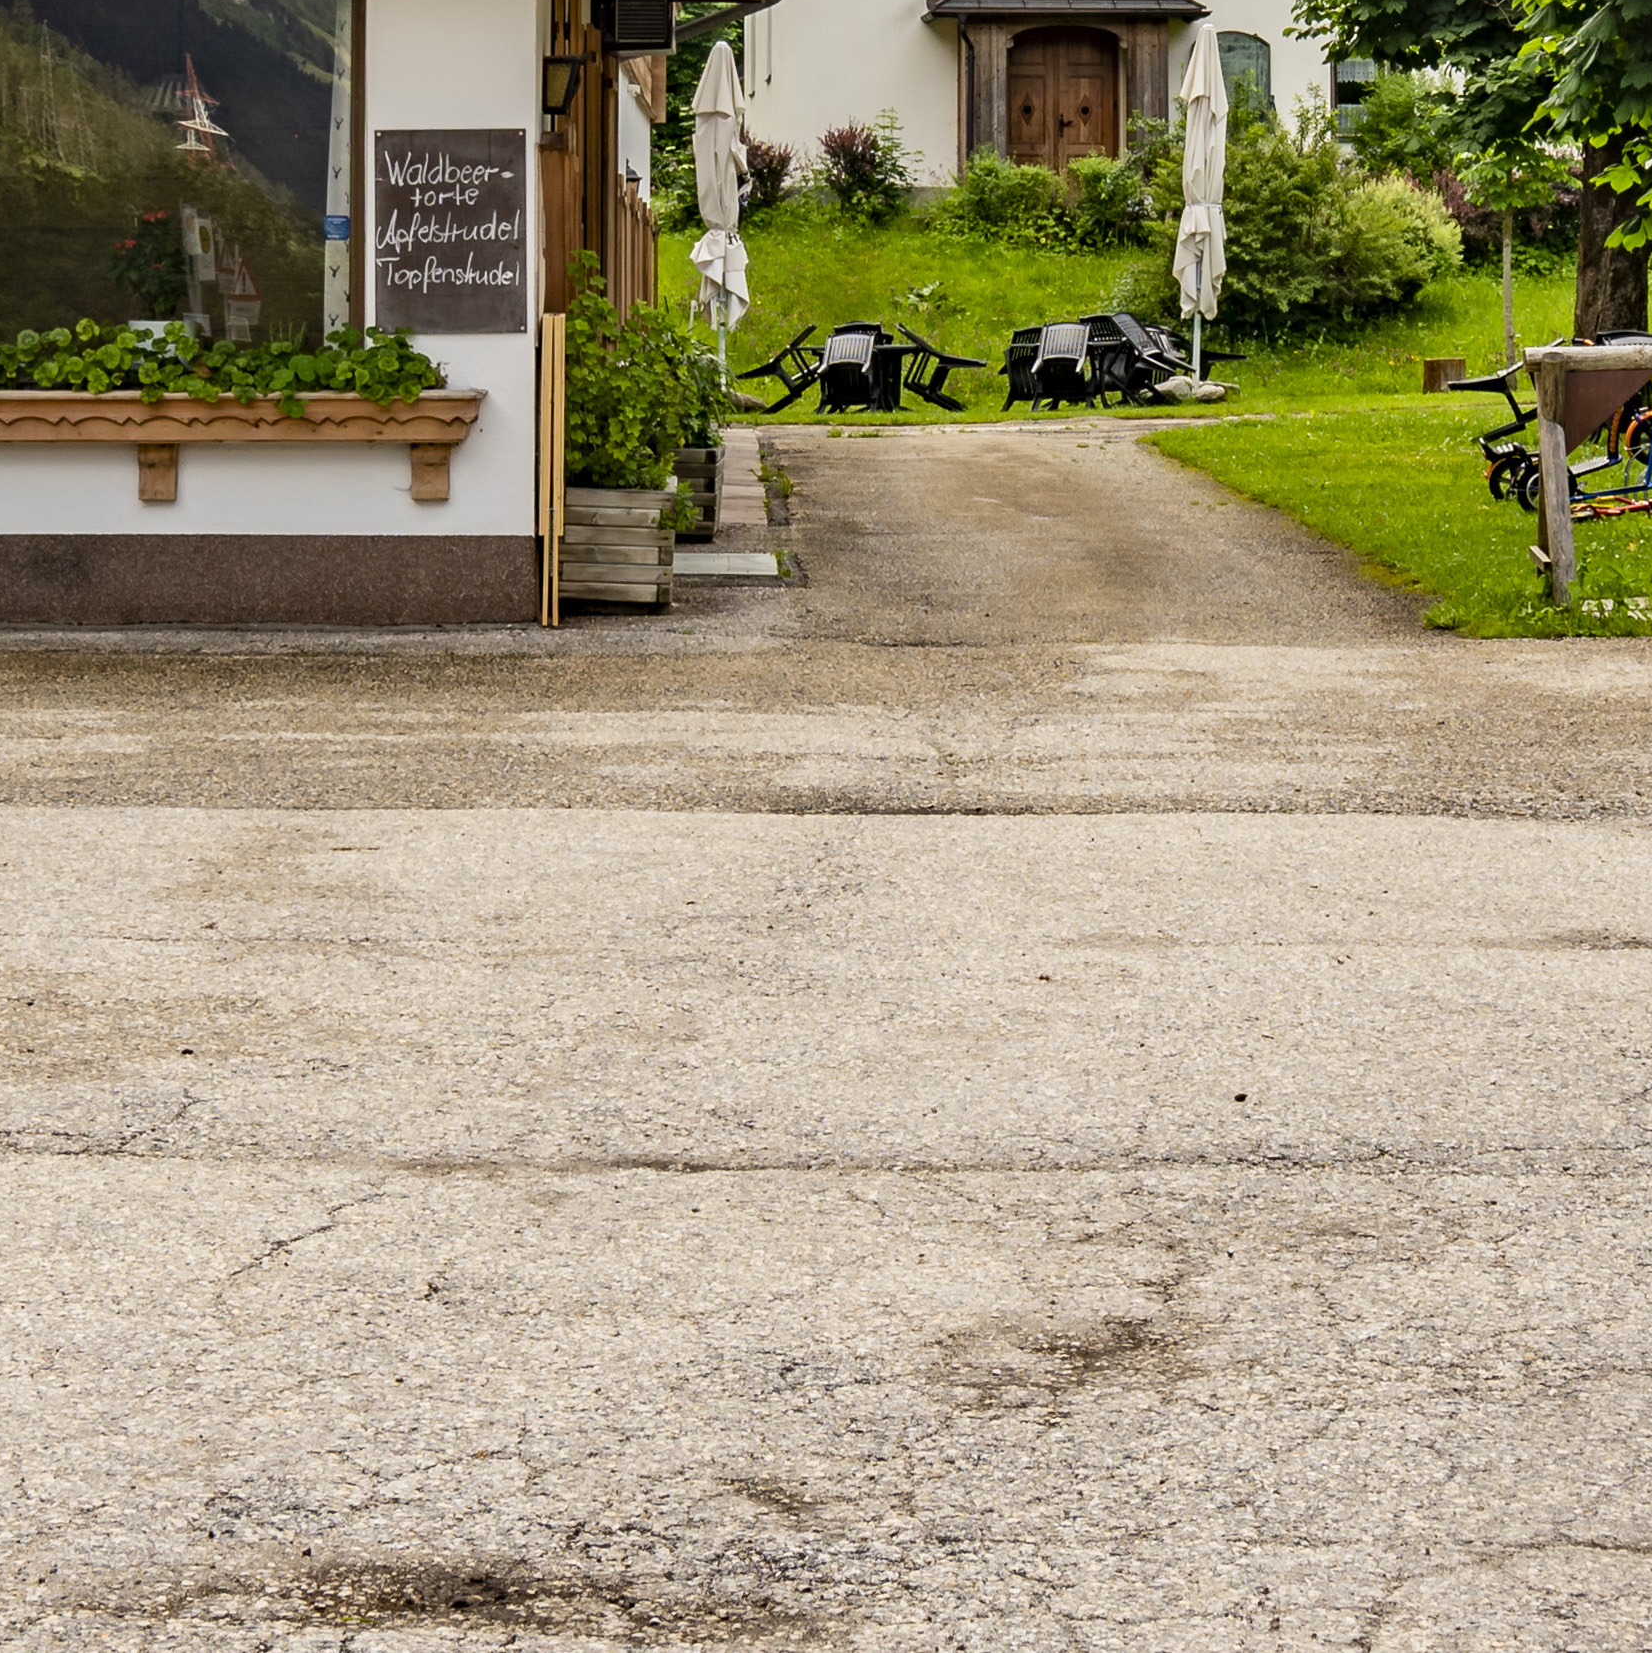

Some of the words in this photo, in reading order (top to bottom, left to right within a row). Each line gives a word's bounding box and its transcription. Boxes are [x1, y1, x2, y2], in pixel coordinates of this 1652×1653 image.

[384, 150, 515, 187] Waldbeer-
[410, 183, 479, 208] torte
[376, 208, 520, 254] Apfelstrudel
